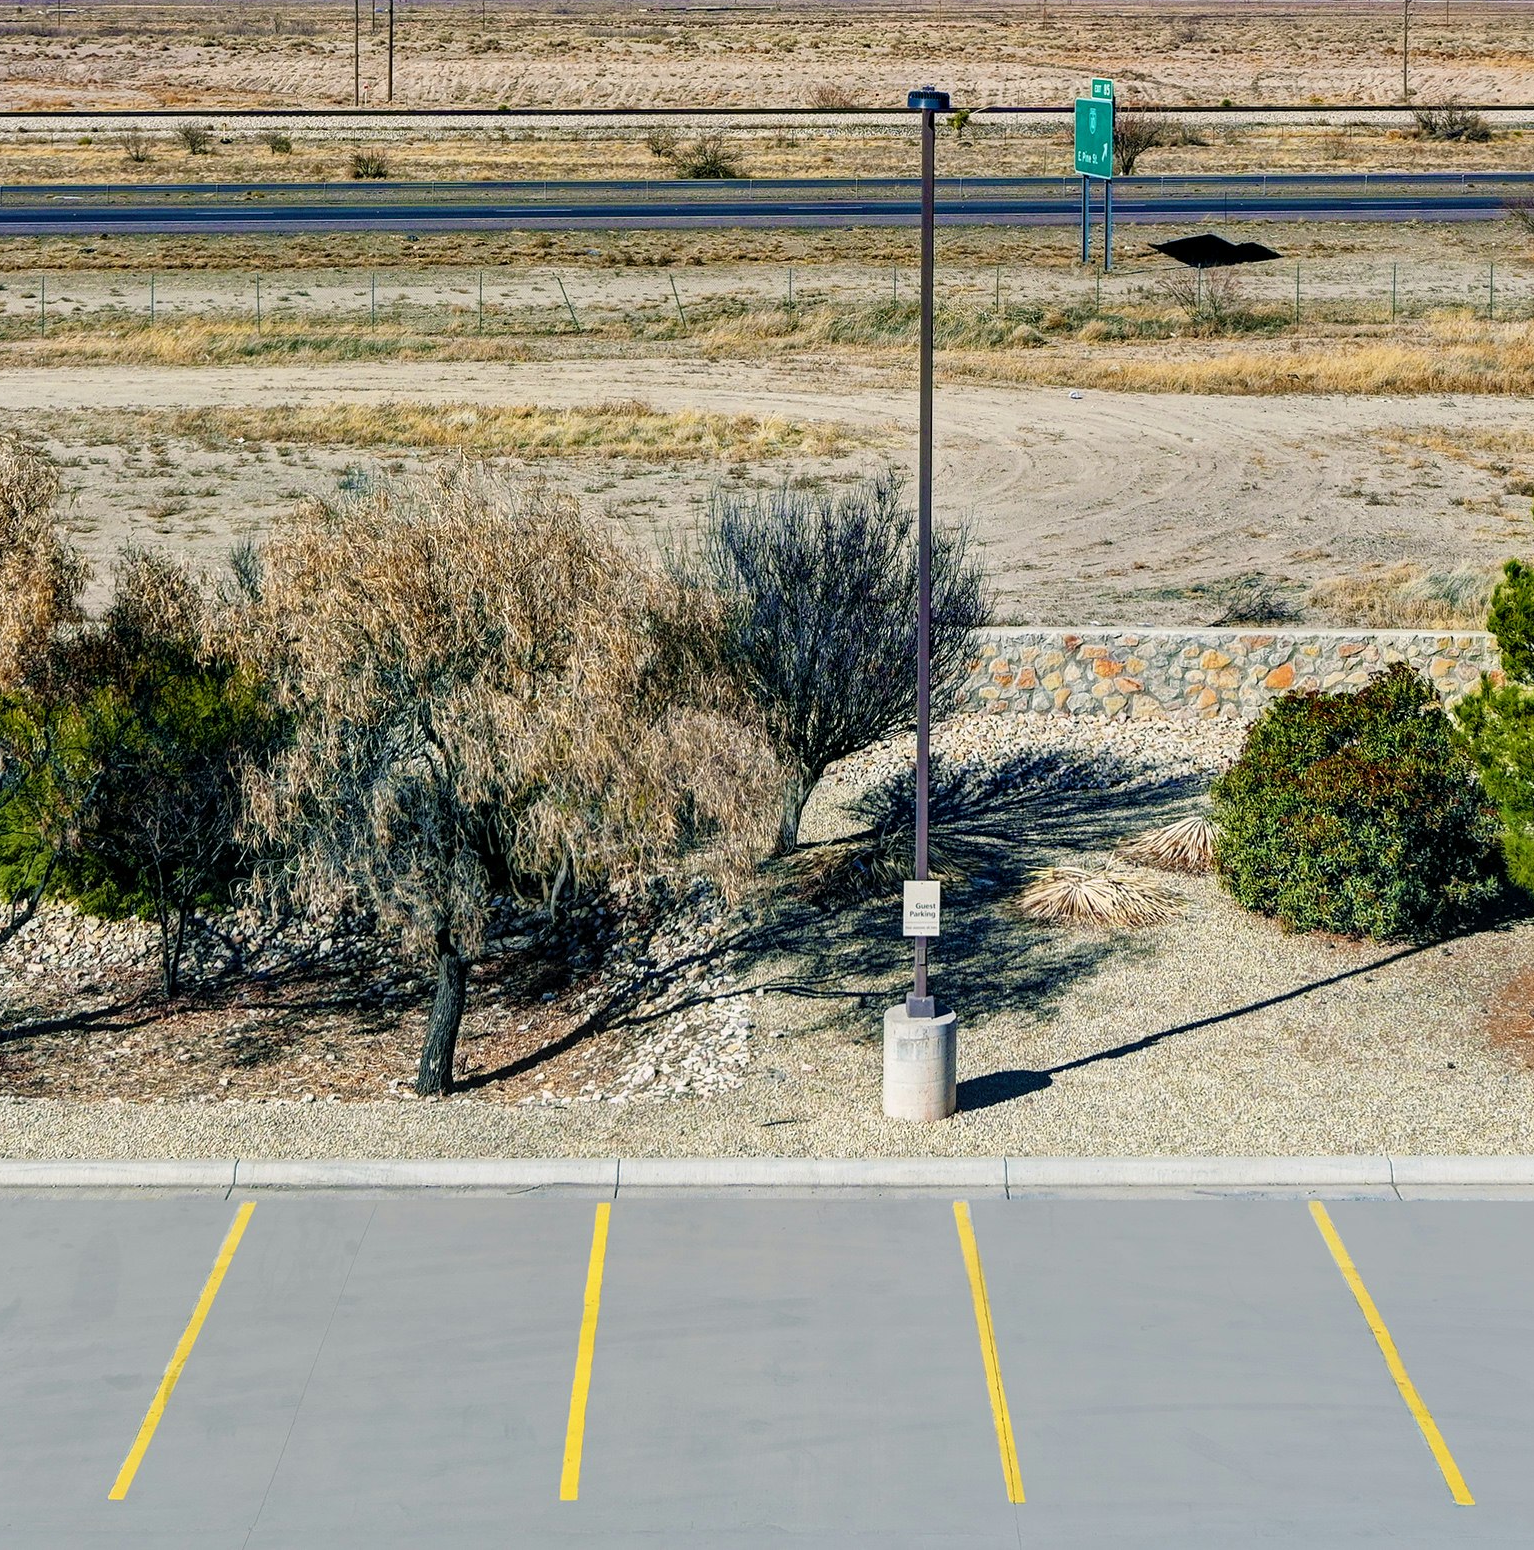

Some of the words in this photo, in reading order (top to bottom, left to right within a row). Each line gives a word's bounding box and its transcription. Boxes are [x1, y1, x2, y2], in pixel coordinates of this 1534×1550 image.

[1094, 84, 1102, 93] EXIT
[915, 902, 936, 910] Guest
[909, 911, 936, 919] Parking
